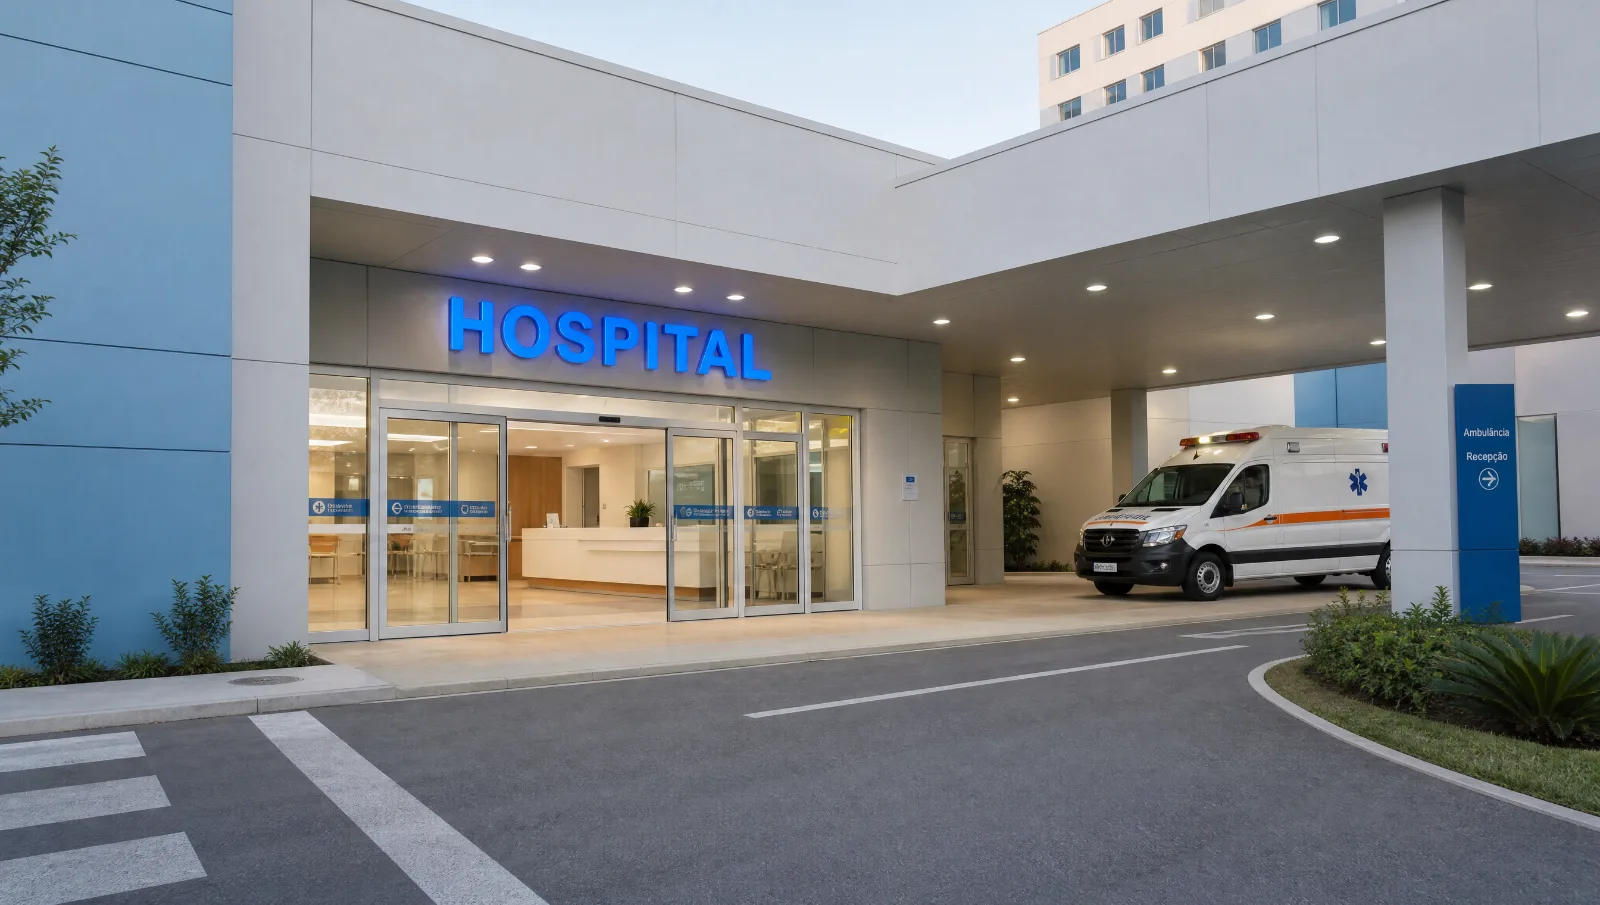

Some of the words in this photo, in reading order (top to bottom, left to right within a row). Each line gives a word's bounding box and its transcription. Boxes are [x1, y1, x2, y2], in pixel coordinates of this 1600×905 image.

[449, 296, 772, 381] HOSPITAL
[1463, 428, 1510, 437] Ambulância
[1466, 452, 1508, 463] Recepção
